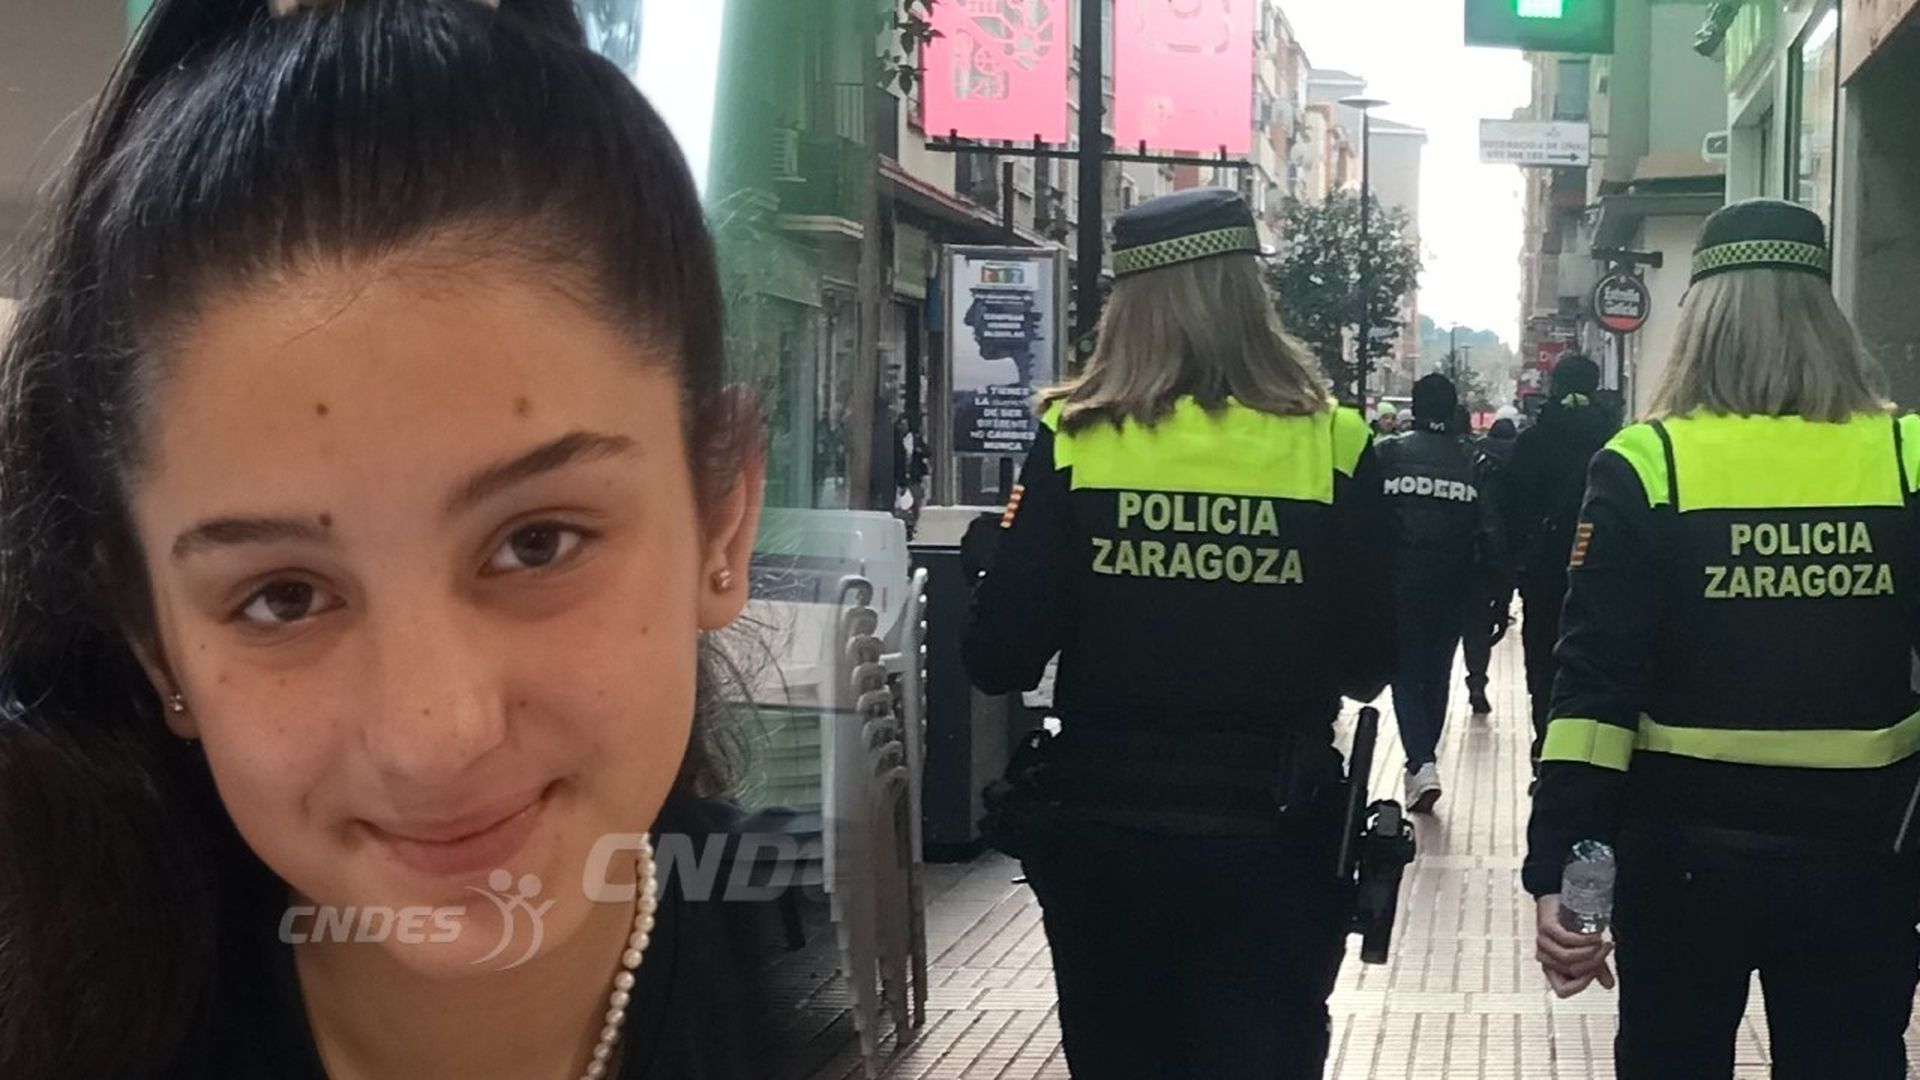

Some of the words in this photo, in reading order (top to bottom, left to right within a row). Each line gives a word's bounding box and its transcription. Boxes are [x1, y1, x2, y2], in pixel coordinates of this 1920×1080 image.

[1117, 491, 1279, 537] POLICIA
[1731, 521, 1873, 555] POLICIA
[1091, 537, 1304, 584] ZARAGOZA
[1704, 564, 1894, 598] ZARAGOZA
